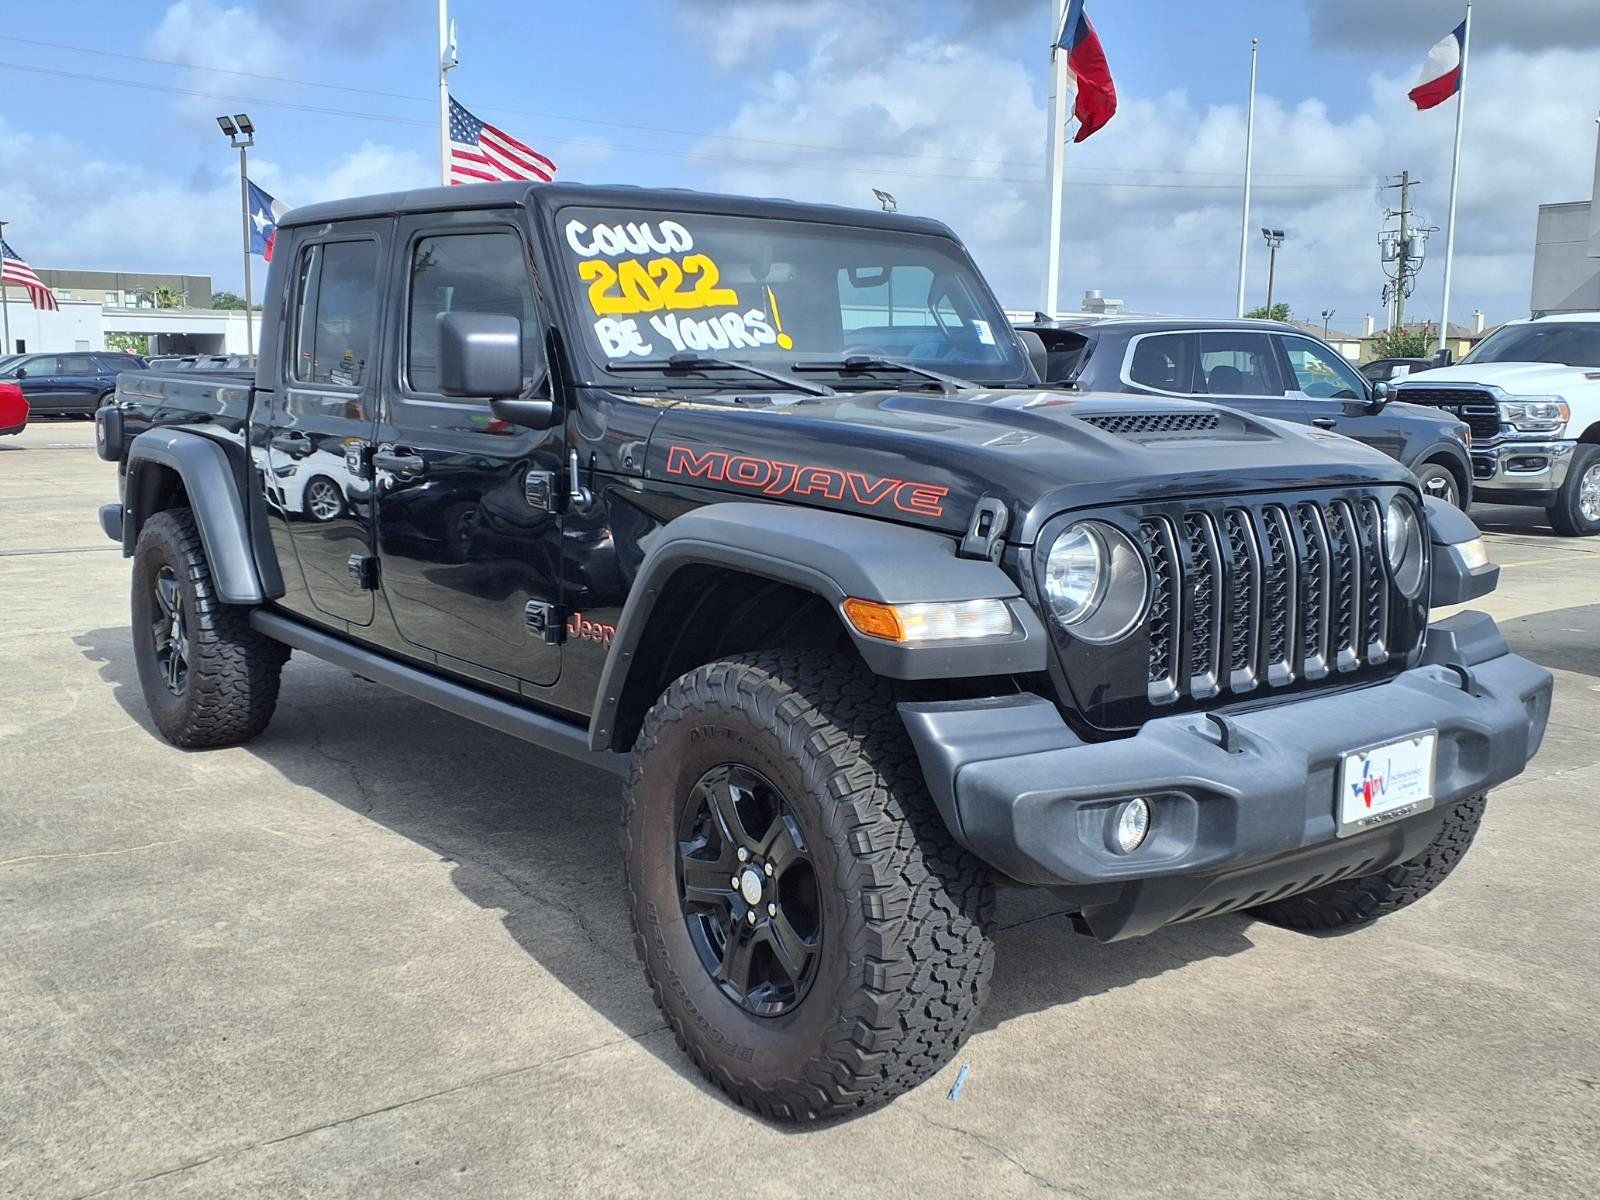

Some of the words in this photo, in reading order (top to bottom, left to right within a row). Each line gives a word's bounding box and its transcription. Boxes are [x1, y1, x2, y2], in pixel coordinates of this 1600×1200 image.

[565, 219, 693, 257] COULD
[578, 253, 739, 316] 2022
[593, 317, 652, 358] BE
[666, 446, 949, 517] MOJAVE
[567, 611, 616, 652] Jeep
